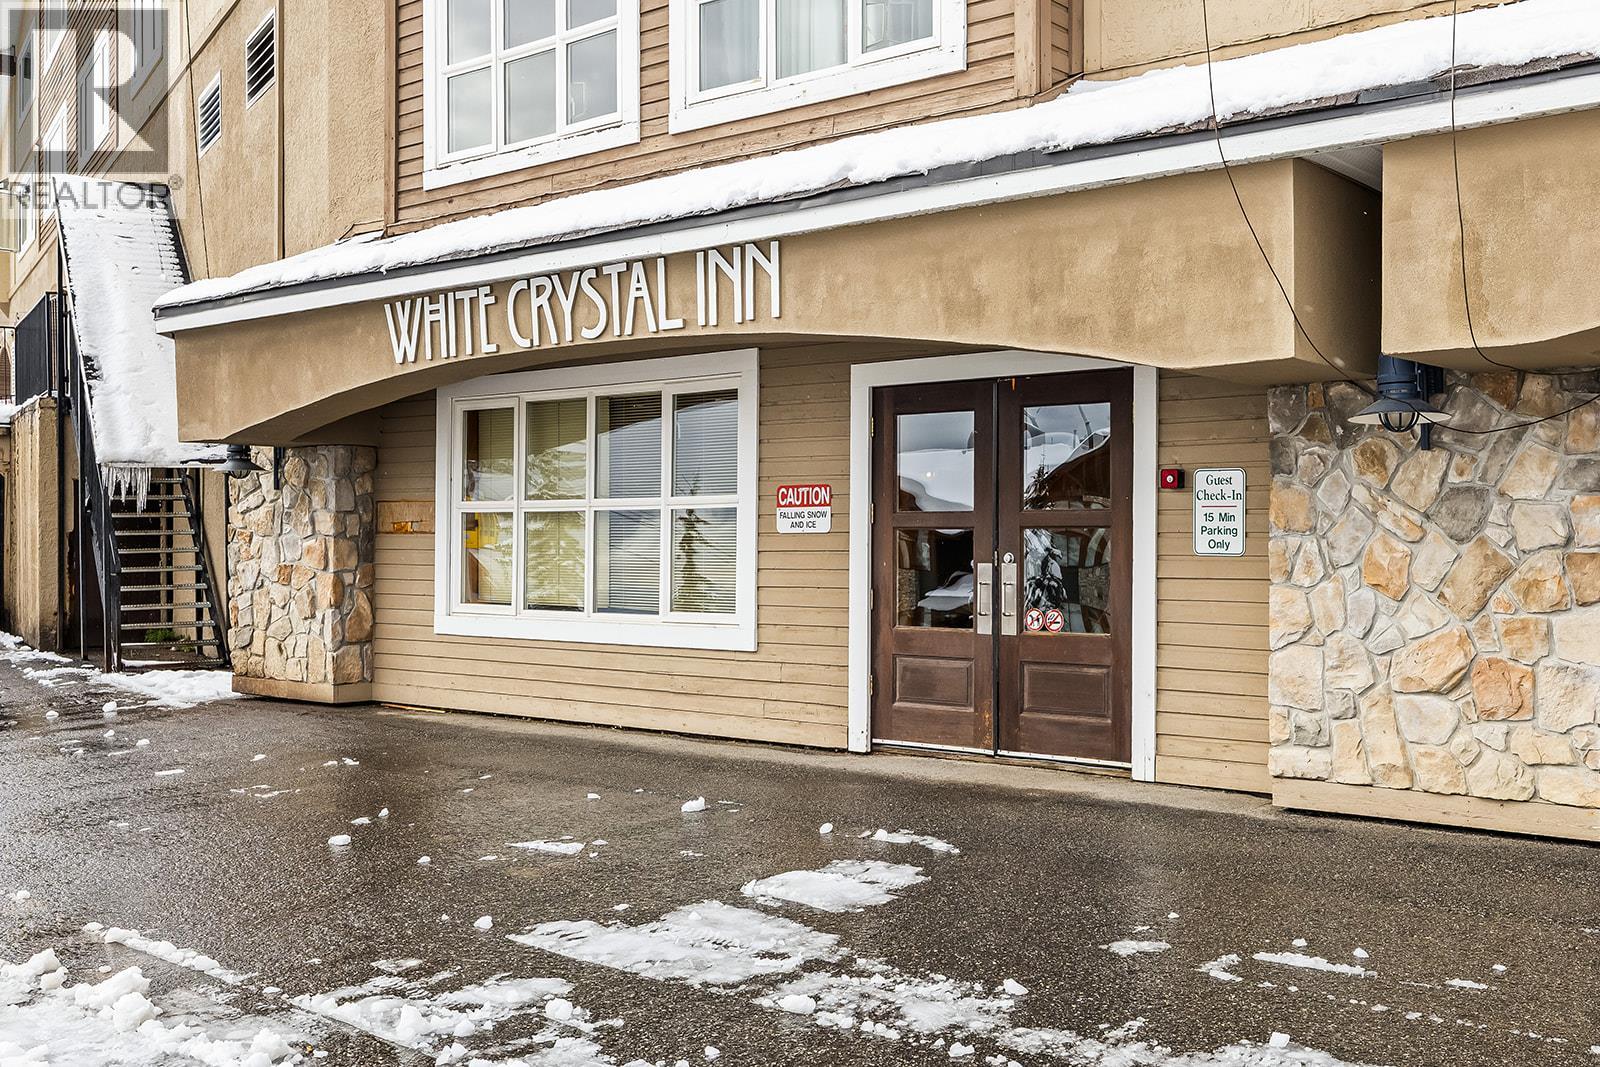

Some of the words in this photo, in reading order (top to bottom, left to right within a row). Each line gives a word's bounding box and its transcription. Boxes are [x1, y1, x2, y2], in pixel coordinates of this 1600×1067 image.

[384, 285, 498, 364] WHITE
[507, 257, 685, 348] CRYSTAL
[695, 240, 780, 326] INN
[1206, 474, 1232, 486] Guest
[778, 486, 830, 506] CAUTION
[1196, 489, 1242, 501] Check-In
[807, 510, 828, 518] SNOW
[1203, 512, 1215, 522] 15
[1218, 512, 1236, 522] Min
[1200, 526, 1238, 538] Parking
[1208, 539, 1230, 551] Only
